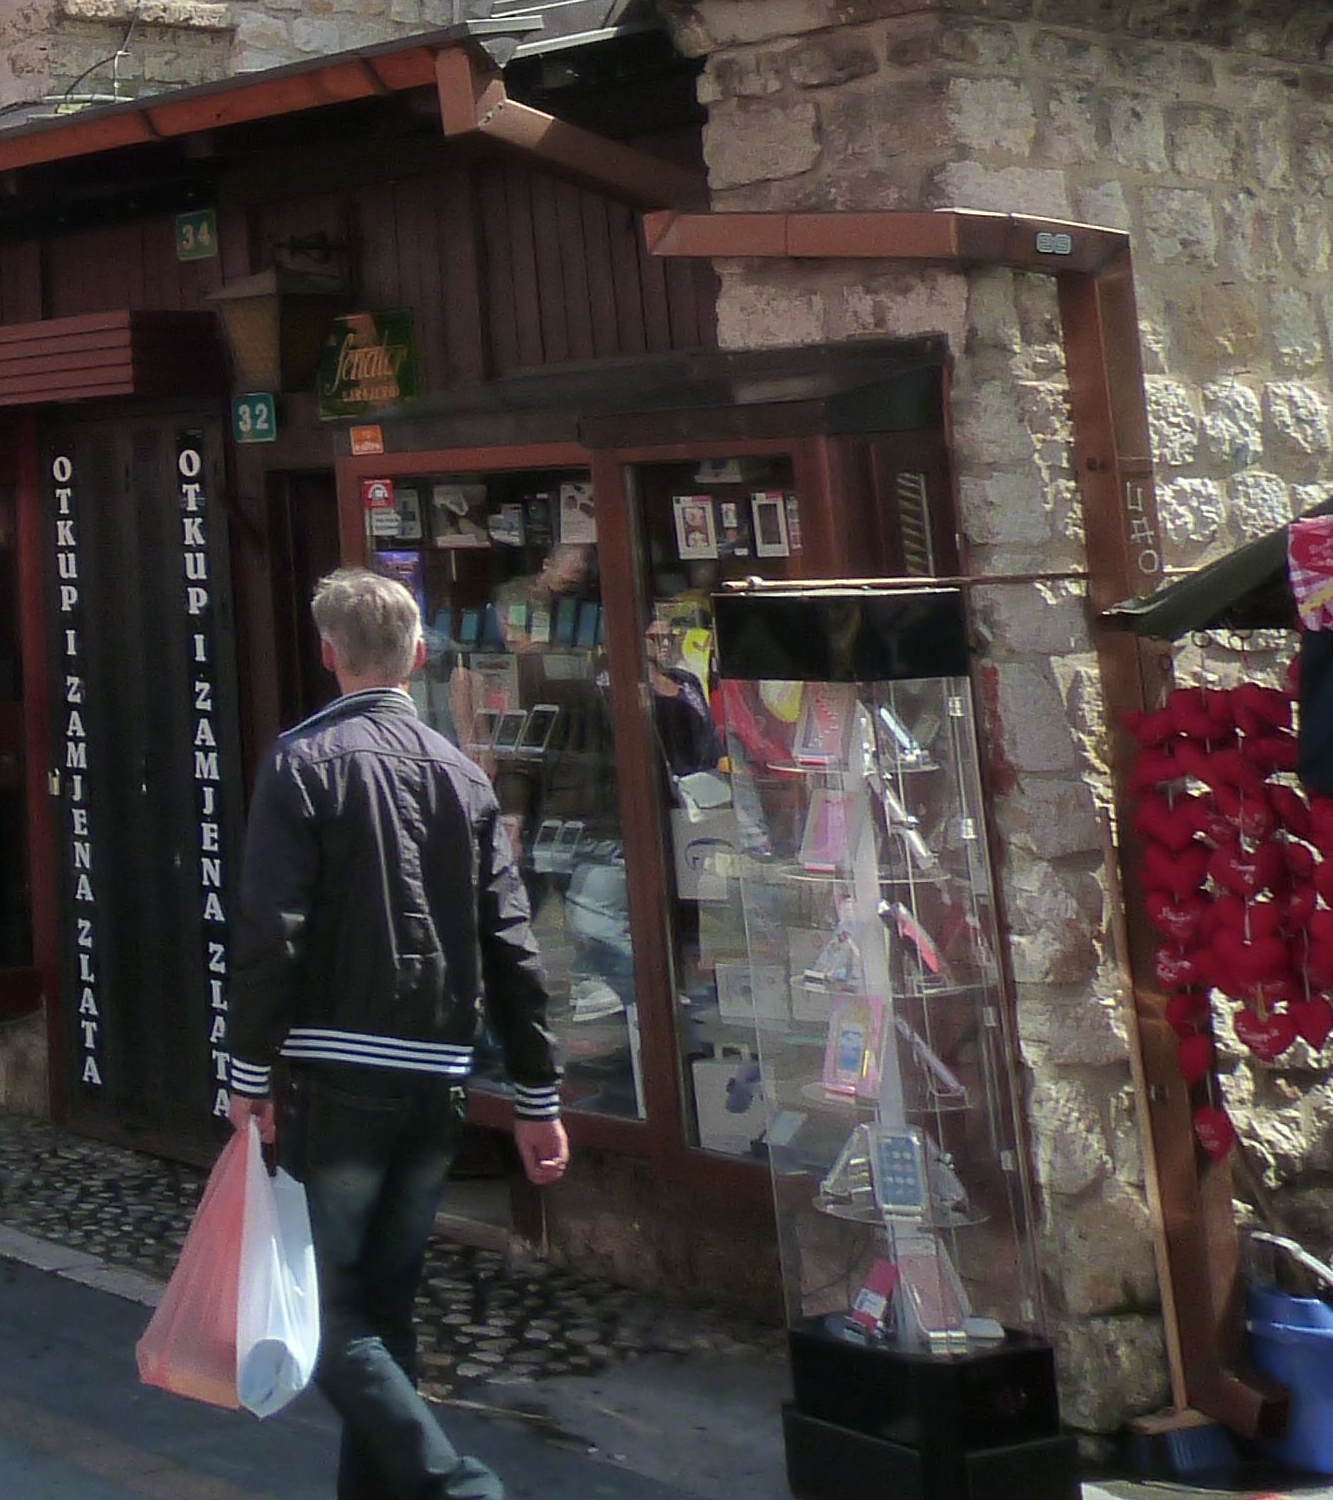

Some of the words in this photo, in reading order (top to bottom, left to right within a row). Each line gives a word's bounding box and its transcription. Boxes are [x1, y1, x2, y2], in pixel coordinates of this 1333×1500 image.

[182, 220, 211, 250] 34
[238, 403, 269, 433] 32
[52, 456, 78, 612] OTKUP
[178, 449, 208, 615] OTKUP
[65, 629, 77, 656] I
[193, 633, 206, 662] I
[65, 675, 94, 902] ZAMJENA
[194, 681, 226, 922] ZAMJENA
[77, 917, 102, 1085] ZLATA
[208, 941, 231, 1119] ZLATA
